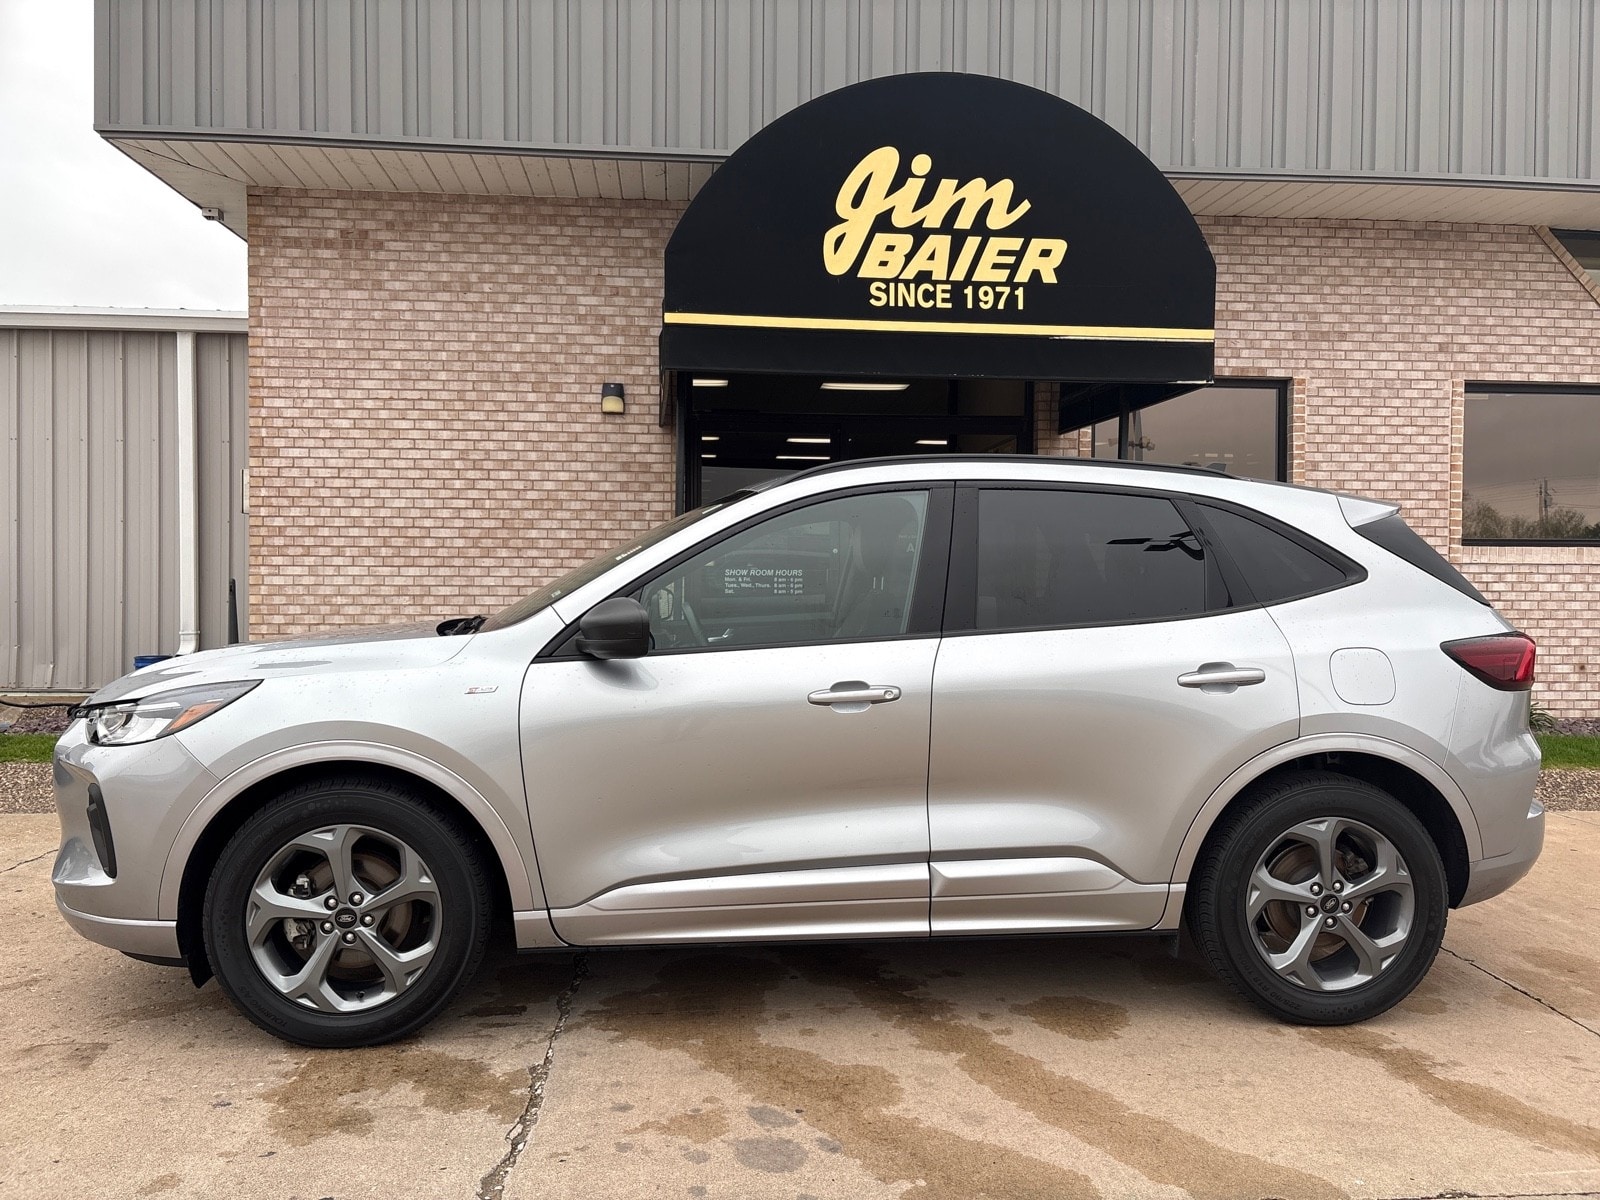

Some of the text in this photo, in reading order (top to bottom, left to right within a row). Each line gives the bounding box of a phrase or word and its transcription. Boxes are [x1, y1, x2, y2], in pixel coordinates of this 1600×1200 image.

[823, 146, 1031, 275] Jim
[857, 233, 1068, 284] BAIER
[869, 281, 1025, 310] SINCE 1971
